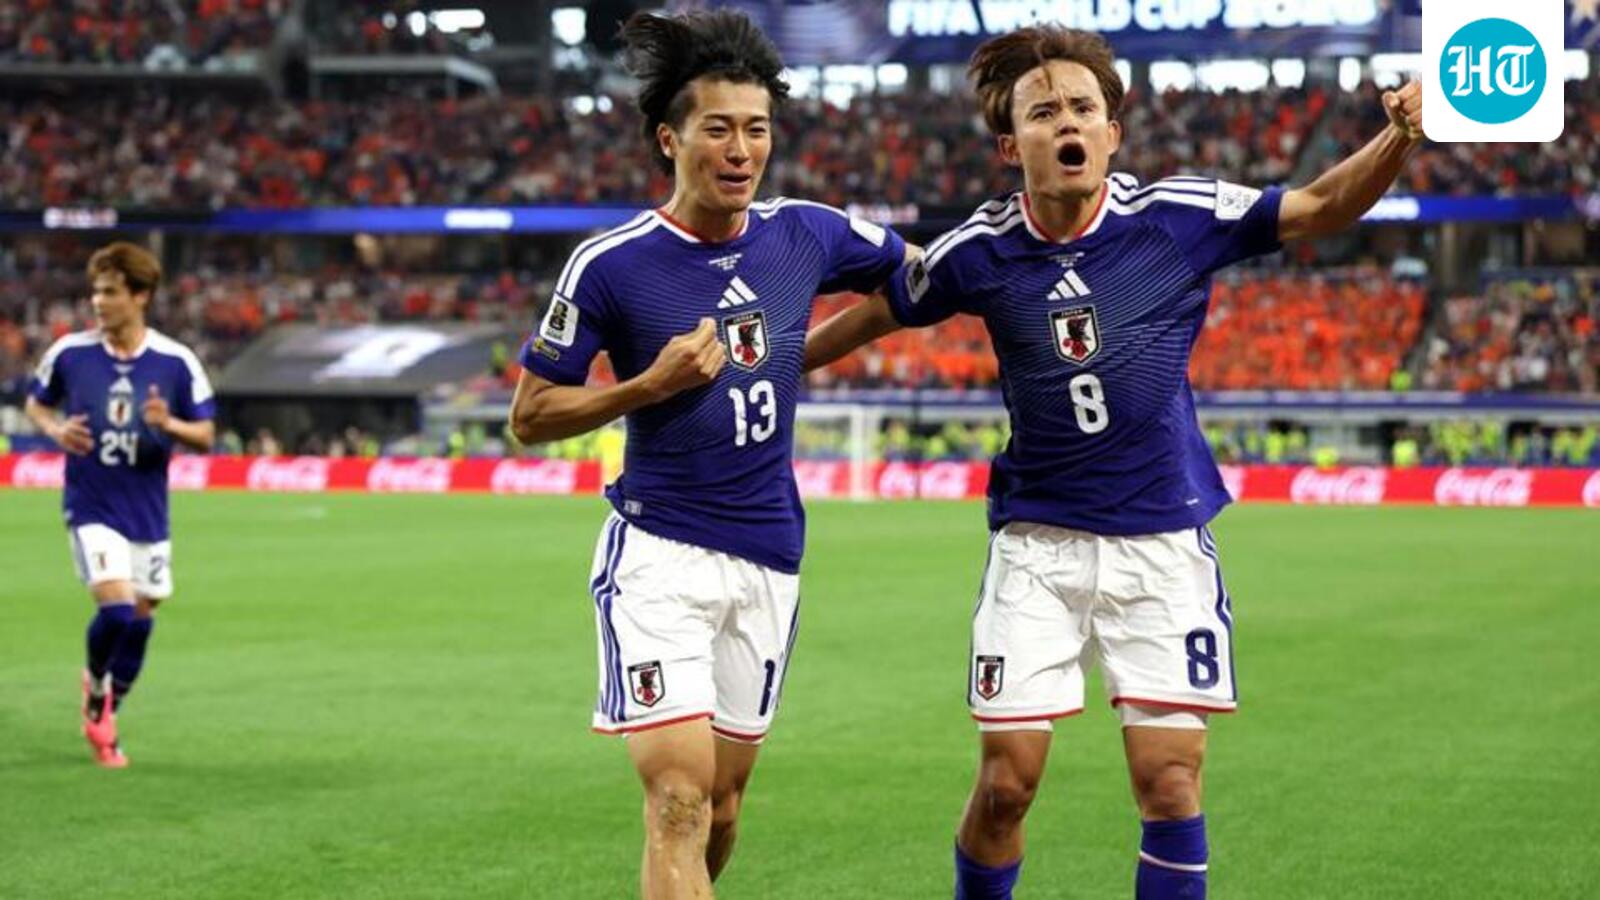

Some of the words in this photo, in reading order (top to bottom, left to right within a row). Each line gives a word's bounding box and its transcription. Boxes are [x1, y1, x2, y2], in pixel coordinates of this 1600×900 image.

[887, 0, 980, 37] FIFA
[979, 0, 1131, 34] WORLD
[1133, 0, 1223, 31] CUP
[728, 380, 778, 447] 13
[1068, 373, 1109, 435] 8
[98, 430, 139, 467] 24
[1184, 627, 1220, 690] 8
